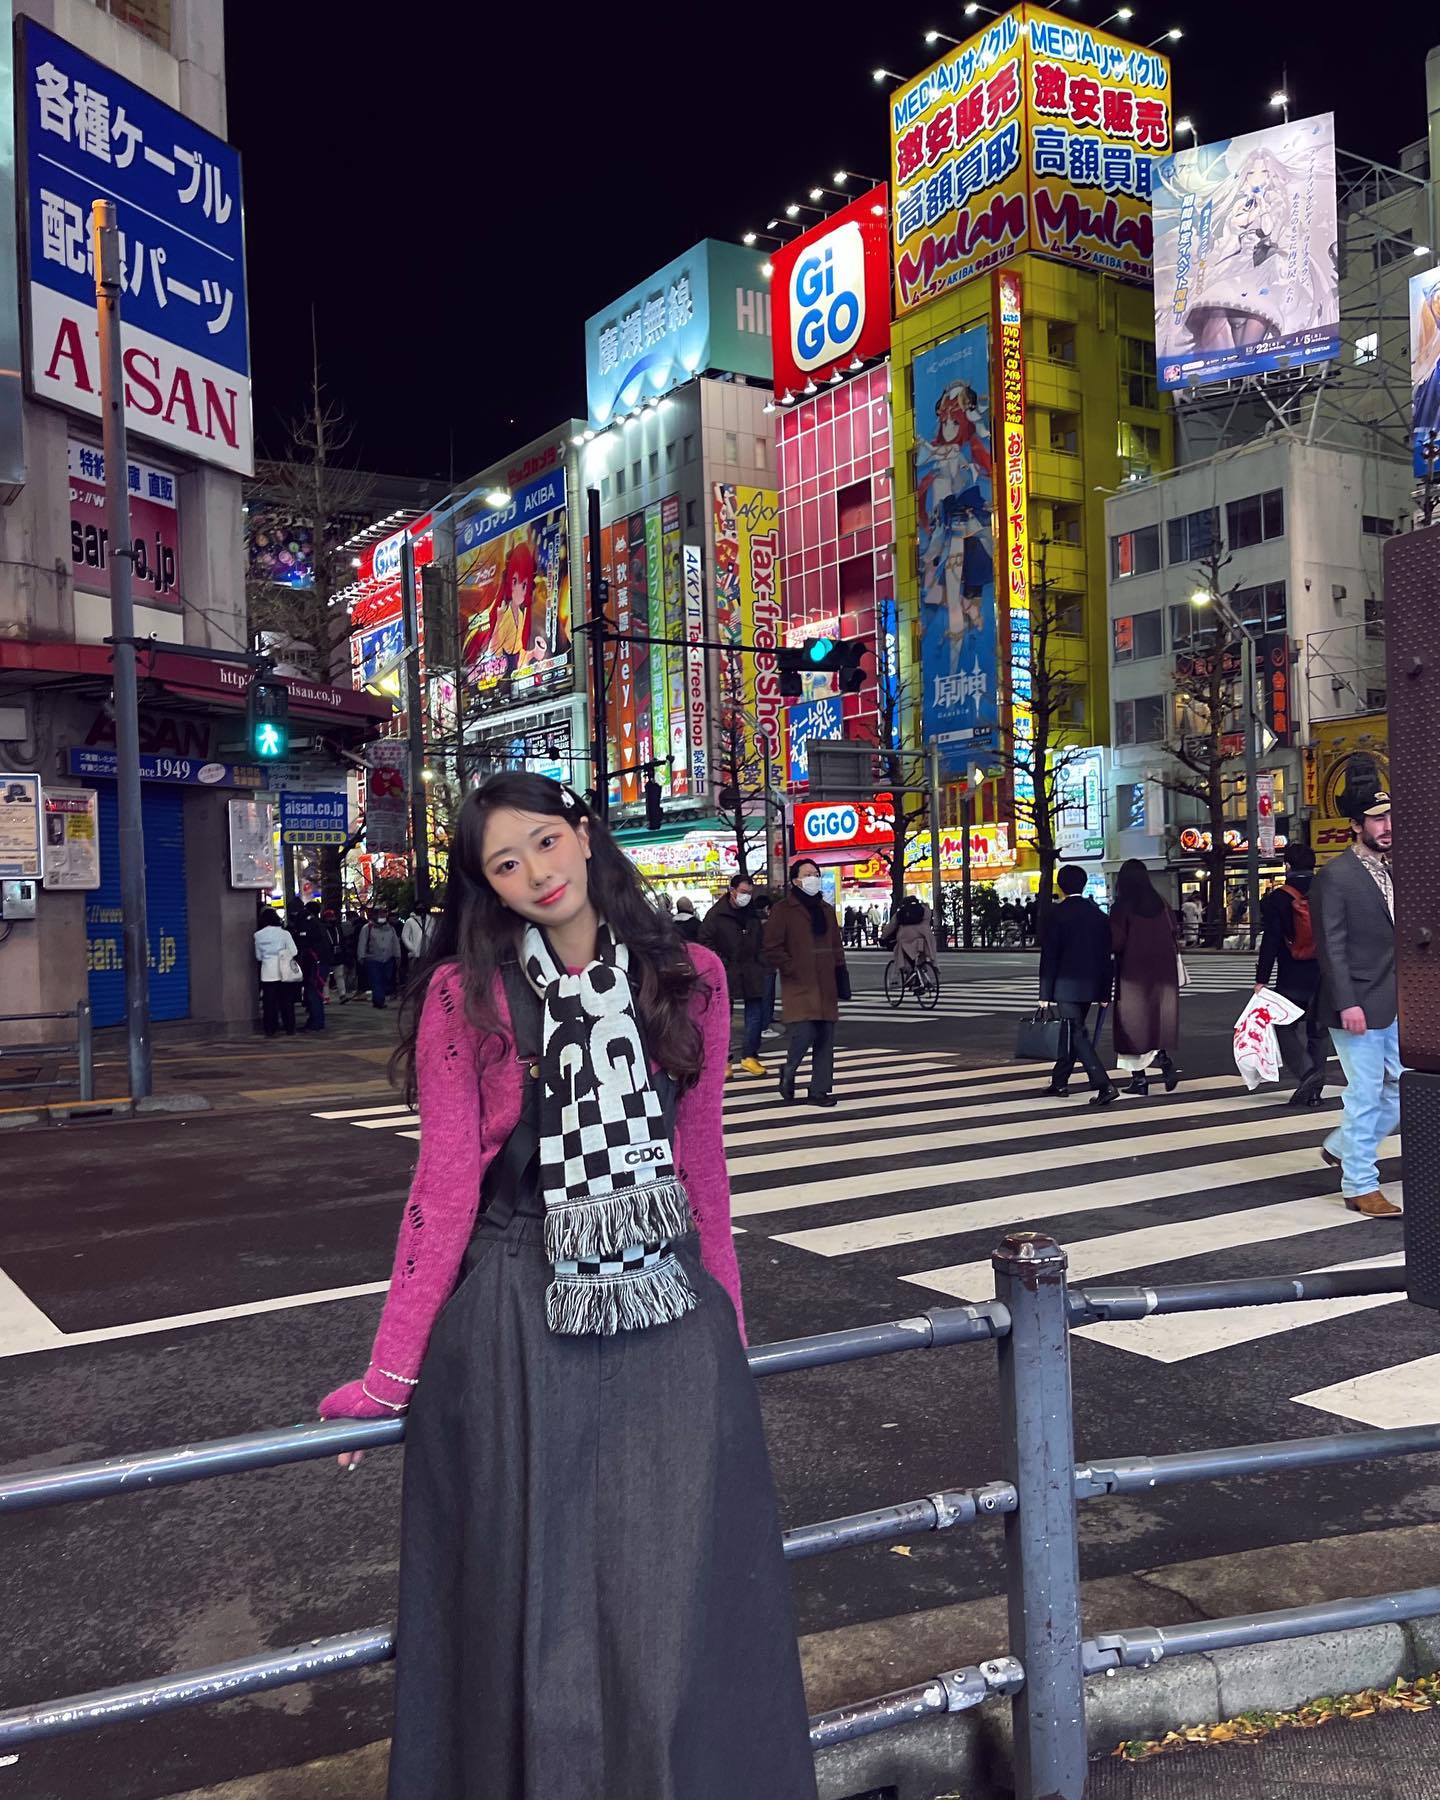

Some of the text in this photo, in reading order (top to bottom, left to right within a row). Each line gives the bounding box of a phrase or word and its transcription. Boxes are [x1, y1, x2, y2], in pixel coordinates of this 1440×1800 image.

[897, 59, 1020, 185] 激安販売
[1032, 61, 1168, 147] 激安販売
[36, 61, 232, 224] 各種ケーブル
[898, 120, 1020, 243] 高額買取
[898, 193, 1027, 307] Mulan
[1092, 252, 1122, 269] AKIBA
[912, 279, 946, 305] ムーラン
[947, 265, 974, 286] AKIBA
[797, 291, 859, 360] GO
[1004, 326, 1019, 337] DVD
[45, 318, 239, 448] ASAN
[1007, 359, 1018, 369] CD
[475, 483, 556, 537] ソフマップ AKIBA
[616, 562, 629, 633] 秋葉原
[932, 654, 987, 718] 原神
[691, 702, 705, 747] Shop
[155, 758, 191, 779] 1949
[284, 800, 345, 818] aisan.co.jp
[807, 810, 856, 837] GiGO
[624, 1146, 666, 1166] CDG
